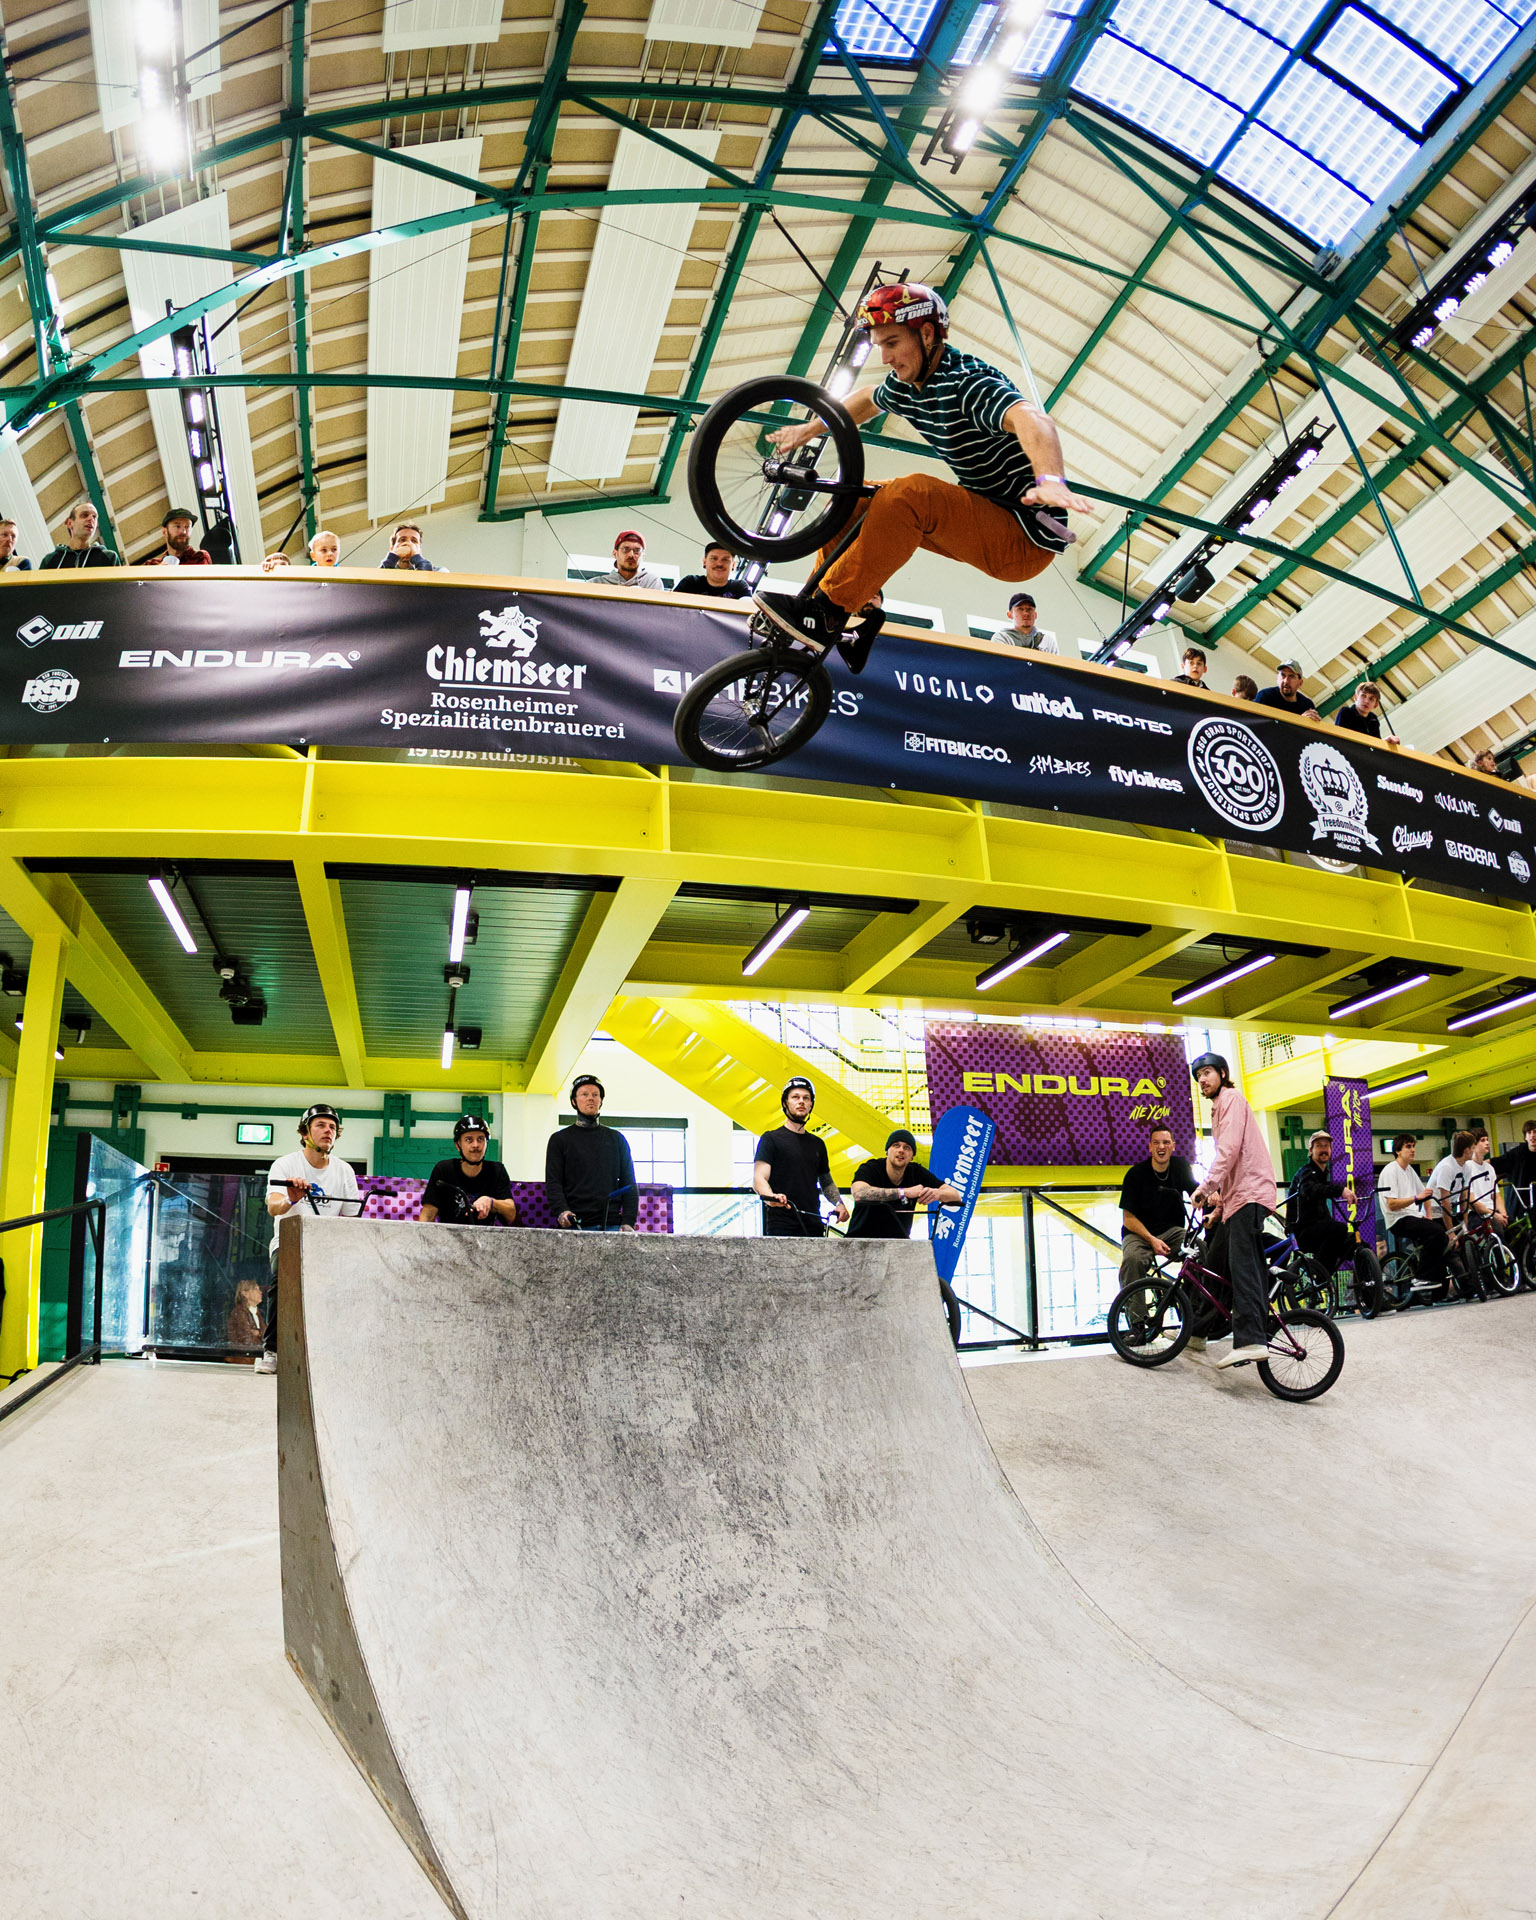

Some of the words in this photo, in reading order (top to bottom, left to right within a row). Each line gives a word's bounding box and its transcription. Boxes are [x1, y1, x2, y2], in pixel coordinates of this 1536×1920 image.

[425, 644, 587, 690] Chiemseer
[22, 679, 80, 703] BSD
[430, 692, 578, 717] Rosenheimer
[380, 708, 626, 739] Spezialitätenbrauerei
[1092, 708, 1173, 736] PRO-TEC
[1196, 735, 1208, 754] 360
[1204, 724, 1226, 739] GRAD
[1226, 725, 1272, 769] SPORTSHOP
[1108, 765, 1183, 793] flybikes
[1210, 754, 1264, 793] 360
[1203, 776, 1250, 821] SPORTSHOP
[1377, 774, 1424, 803] Sunday
[1252, 806, 1272, 823] GRAD
[1333, 832, 1361, 846] AWARDS
[1392, 824, 1434, 853] Odyssey
[1457, 842, 1501, 870] FEDERAL
[1341, 1089, 1357, 1233] NDURA
[952, 1199, 972, 1249] Rosenheimer
[966, 1123, 993, 1200] Spezialitätenbrauerei
